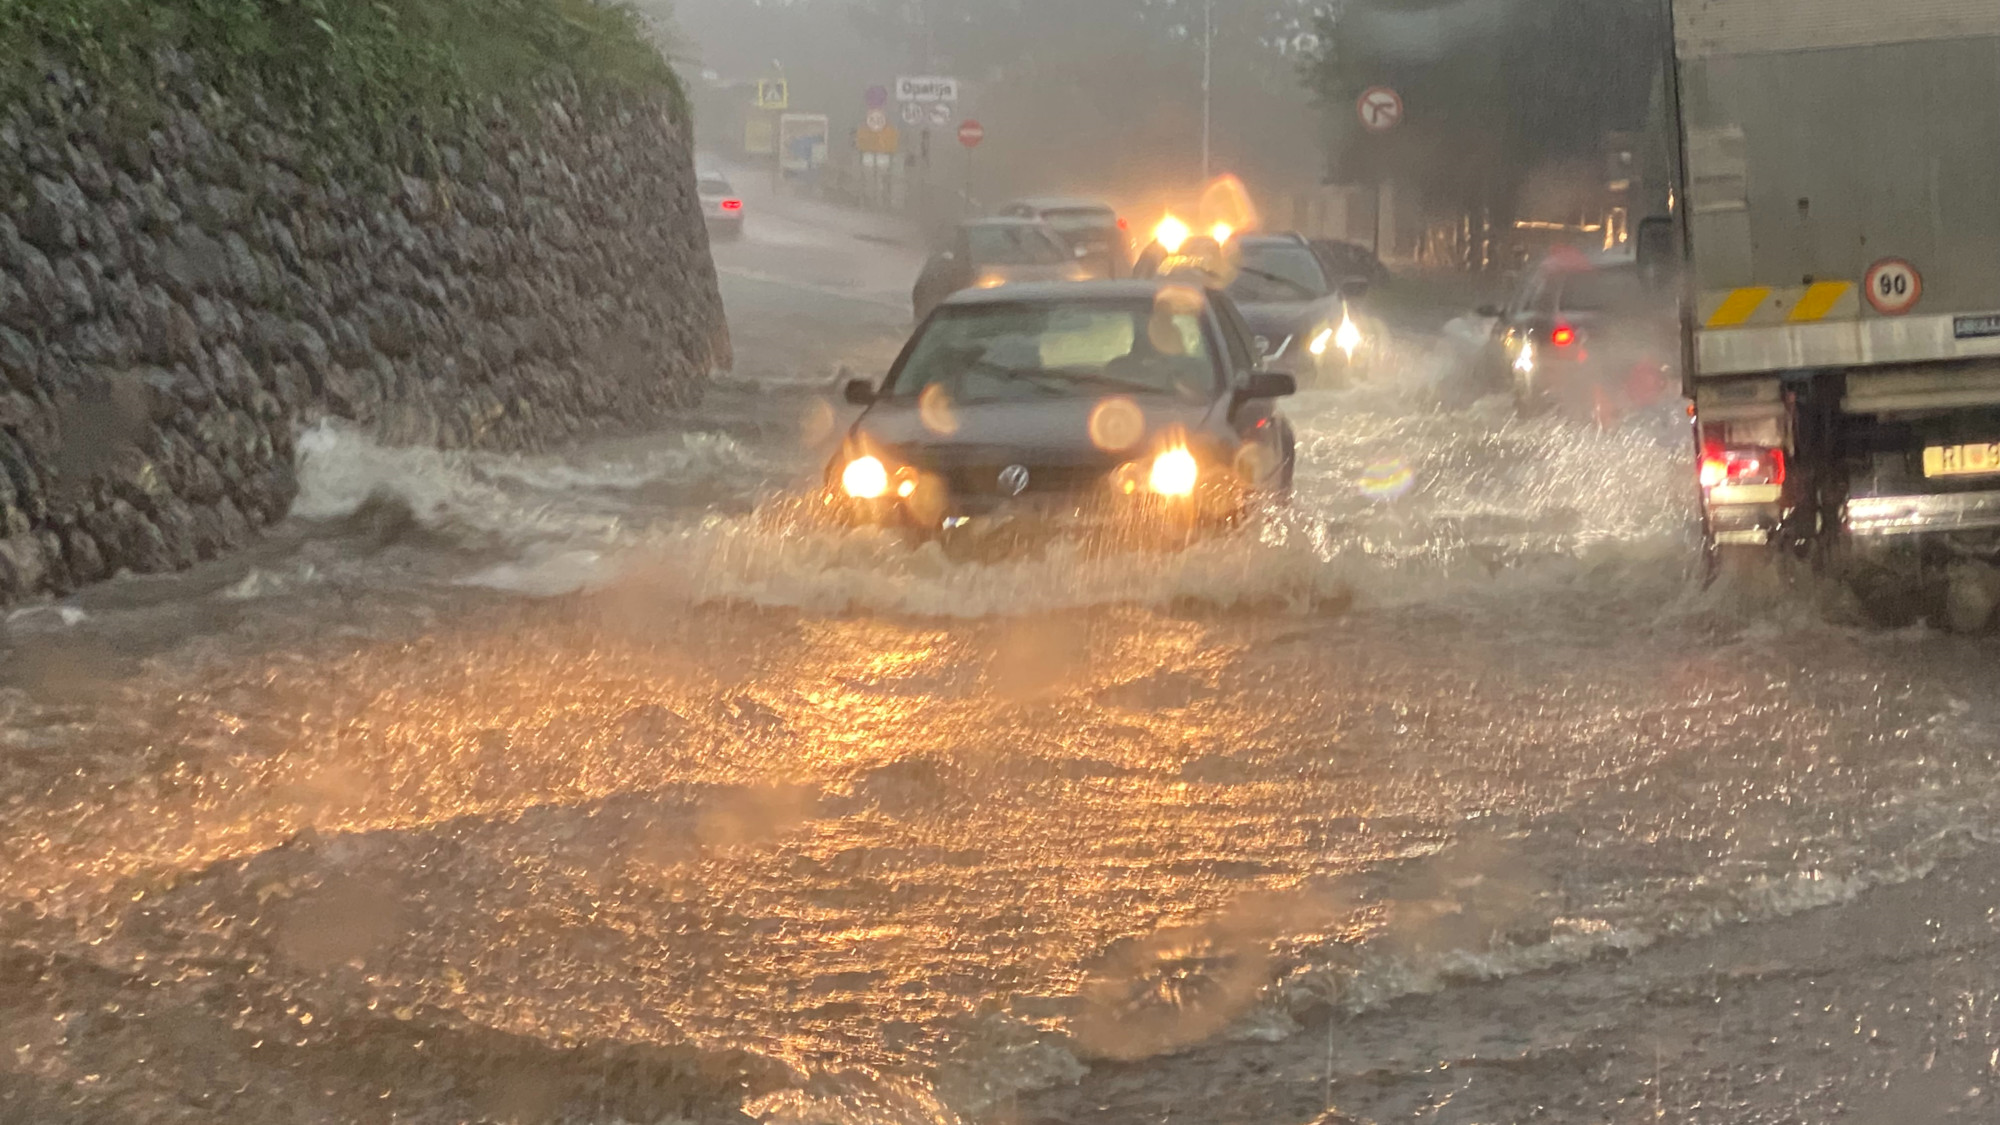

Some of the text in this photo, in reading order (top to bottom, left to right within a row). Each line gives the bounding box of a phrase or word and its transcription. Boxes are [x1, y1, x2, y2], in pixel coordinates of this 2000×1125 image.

[902, 81, 951, 97] Opatija
[1880, 273, 1906, 296] 90
[1942, 445, 1964, 471] RI
